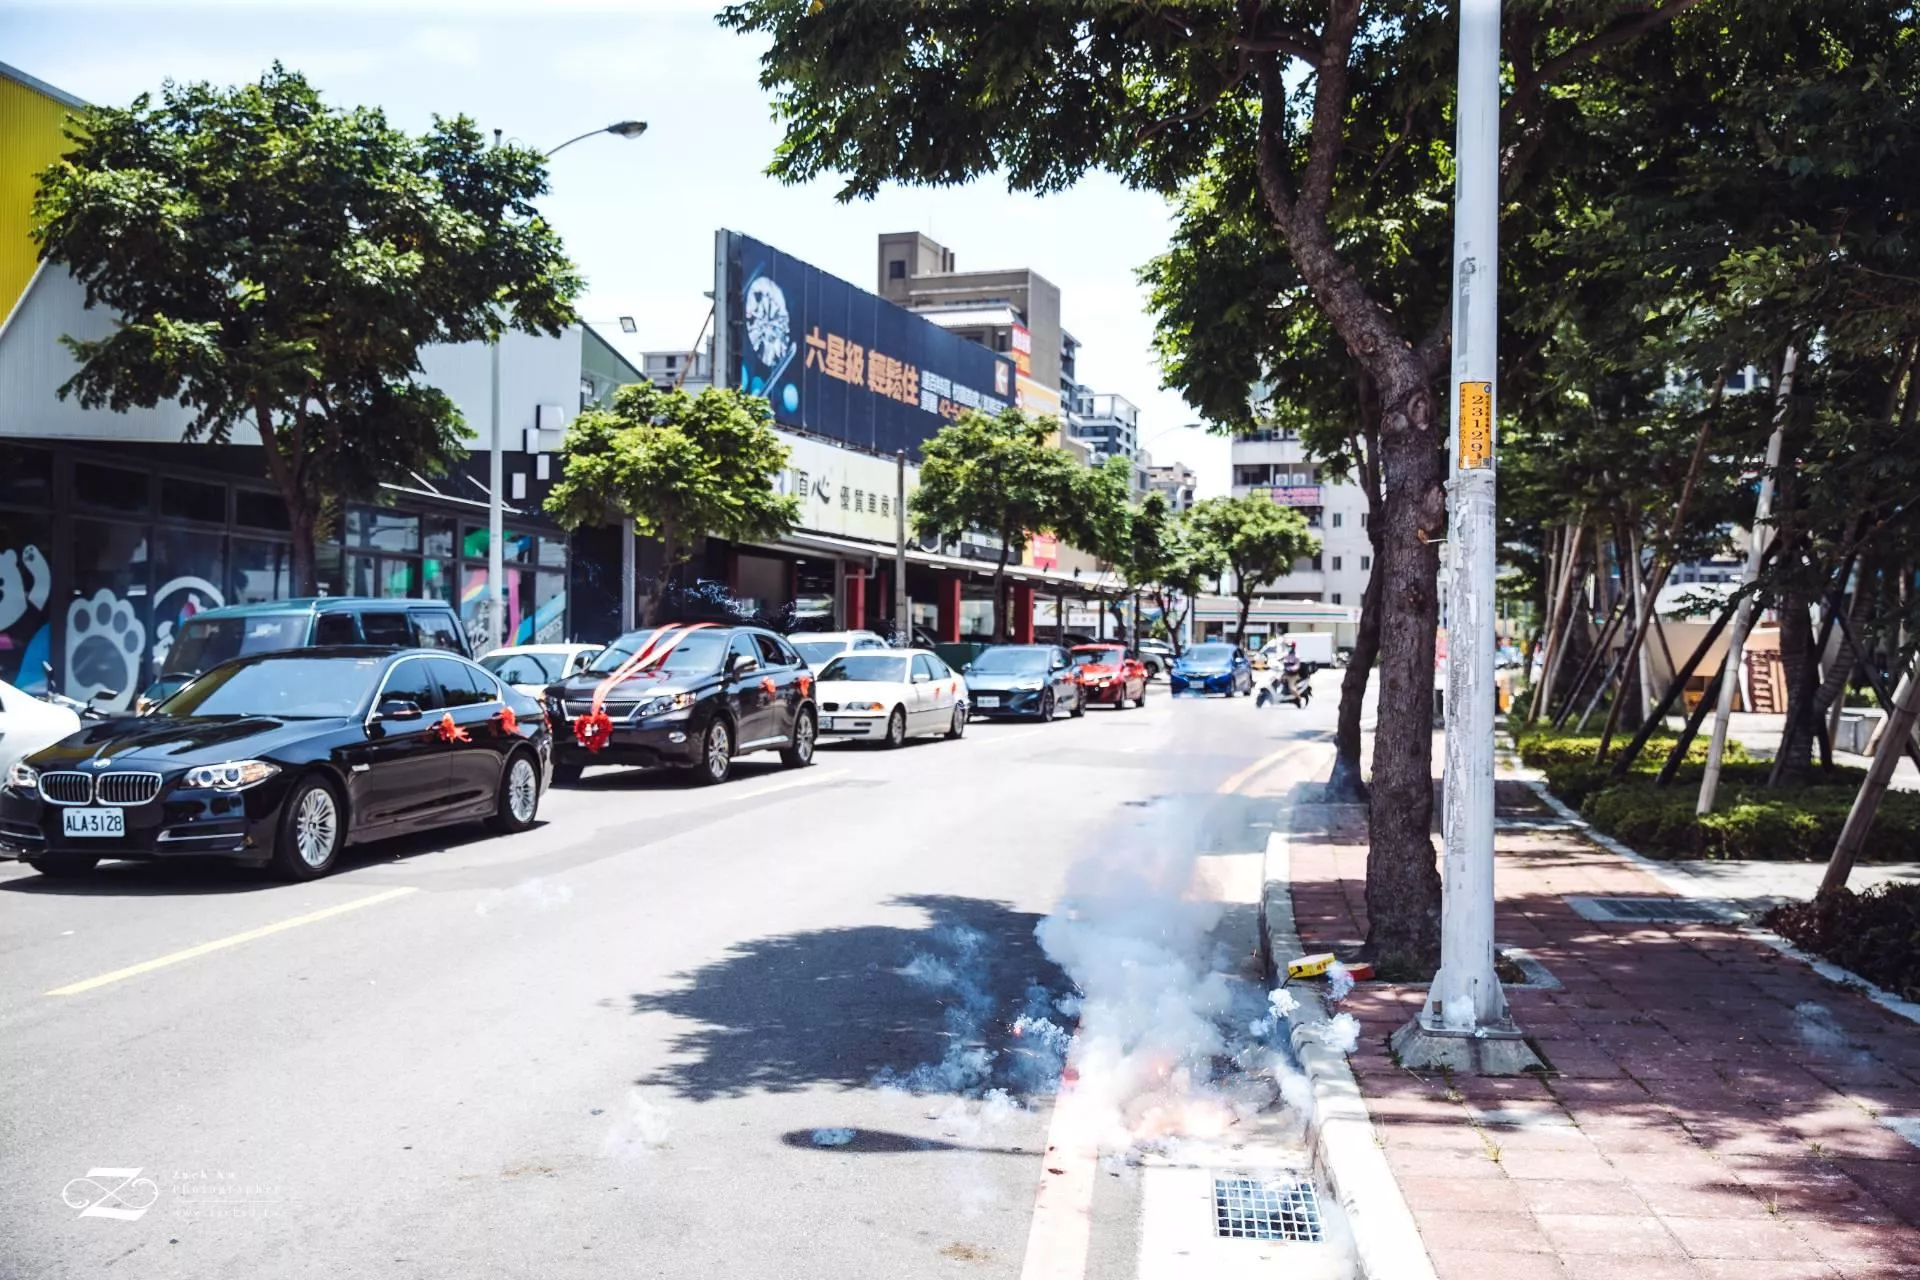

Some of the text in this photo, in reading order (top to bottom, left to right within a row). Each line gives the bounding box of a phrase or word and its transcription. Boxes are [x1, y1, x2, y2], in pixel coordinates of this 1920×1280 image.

[805, 326, 864, 387] 六星級
[868, 349, 919, 406] 輕鬆住
[1471, 395, 1483, 452] 23129
